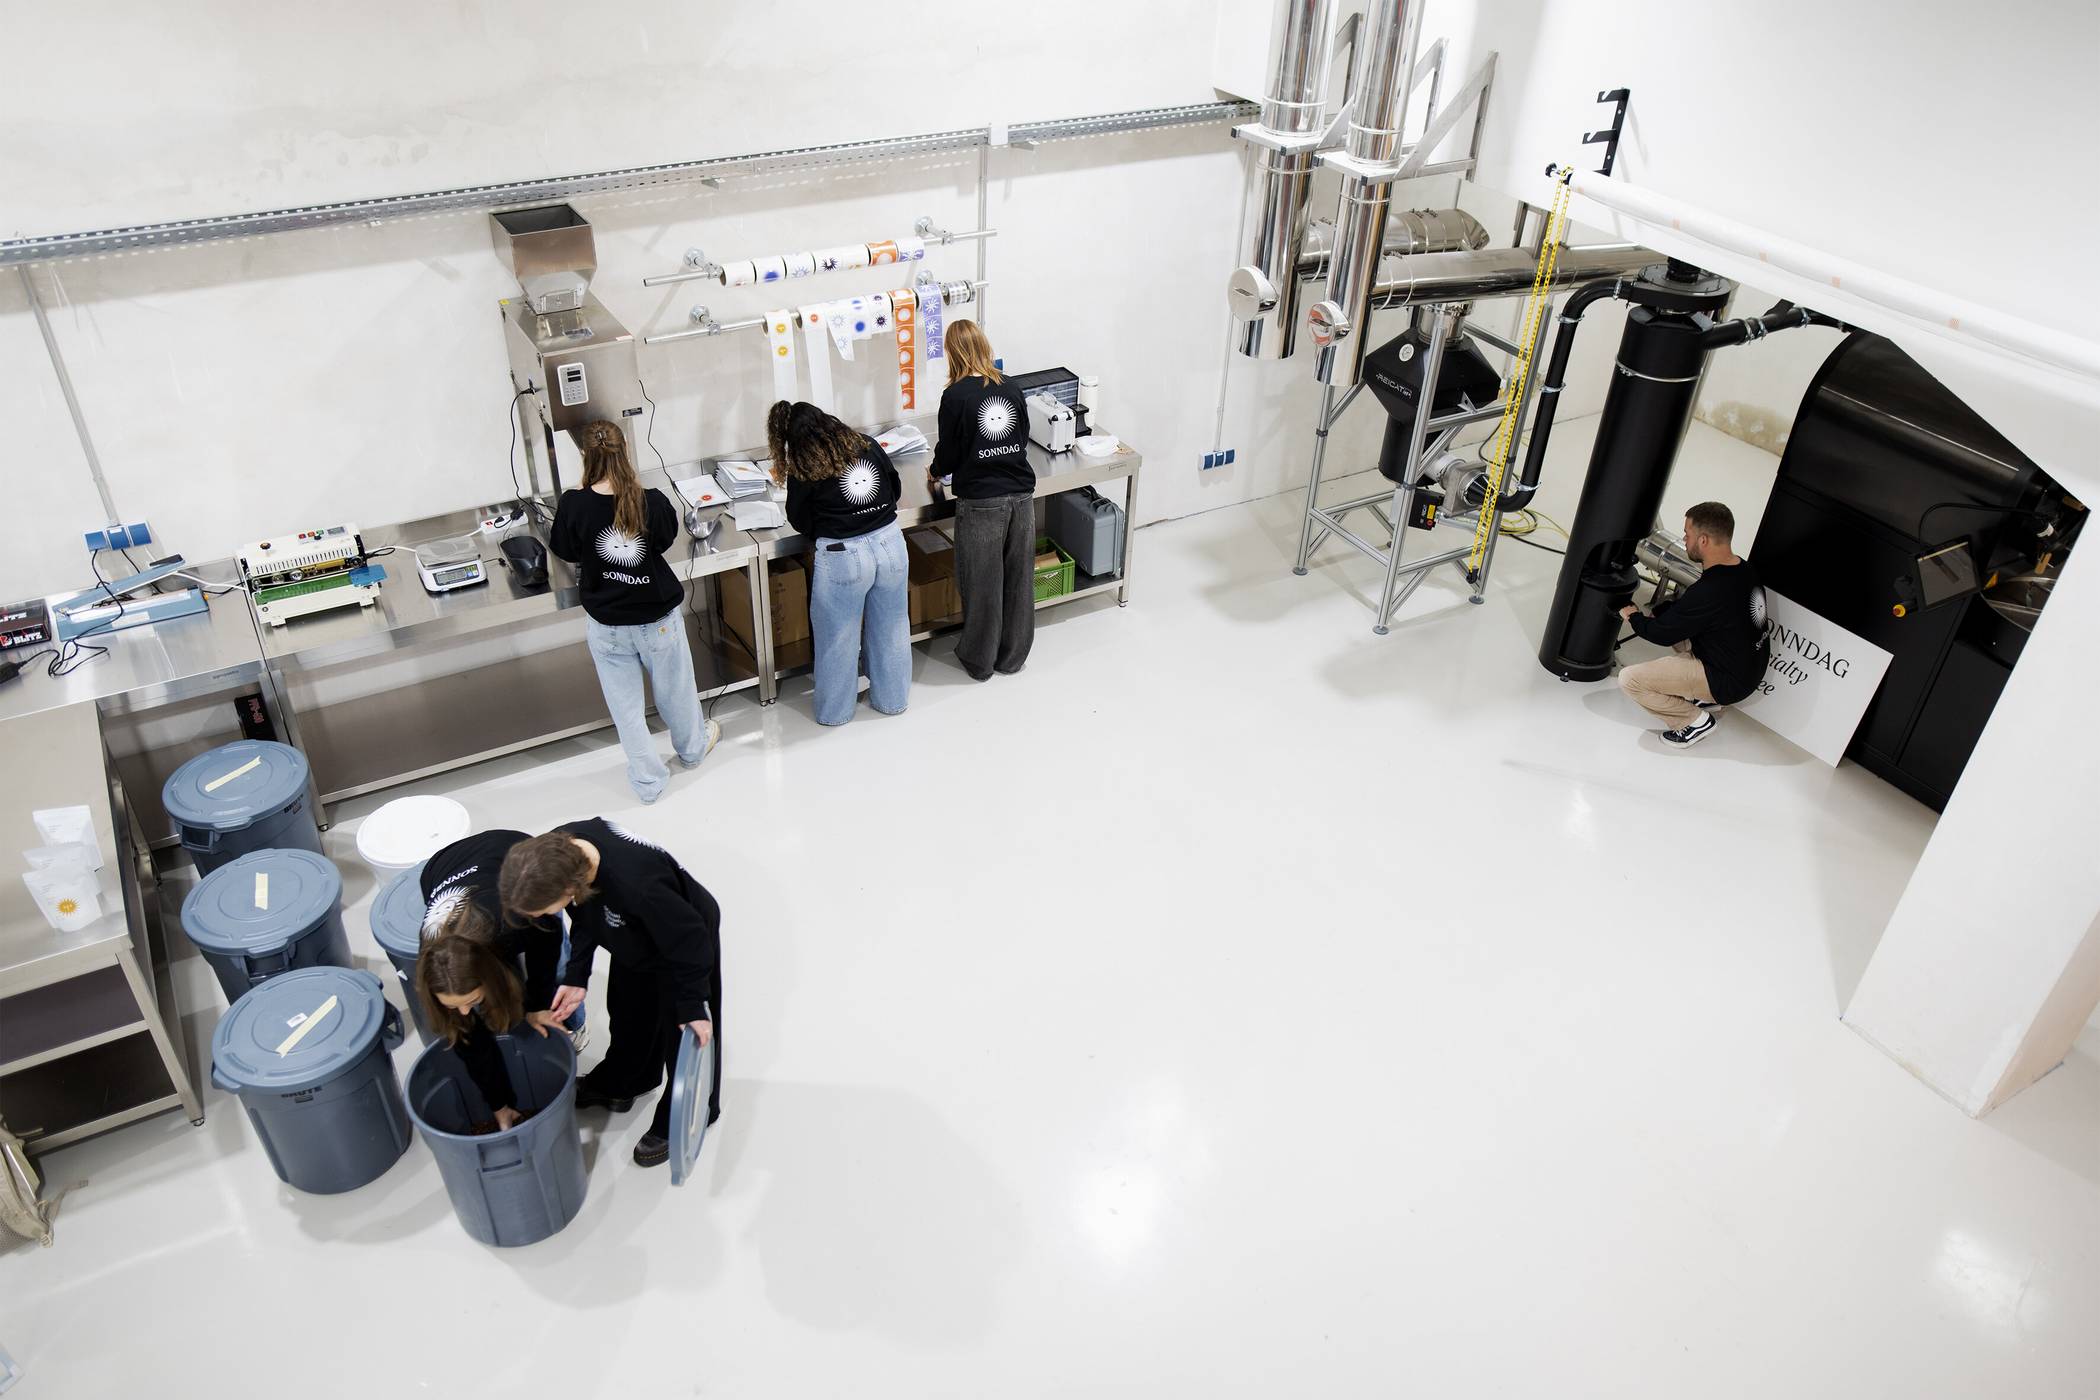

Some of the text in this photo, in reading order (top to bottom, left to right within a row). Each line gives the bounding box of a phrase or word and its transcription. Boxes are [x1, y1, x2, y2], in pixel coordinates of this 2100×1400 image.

[978, 443, 1020, 459] SONNDAG
[602, 571, 650, 585] SONNDAG
[13, 631, 43, 645] BLITZ
[1766, 618, 1850, 679] NNDAG
[1769, 653, 1808, 686] ialty
